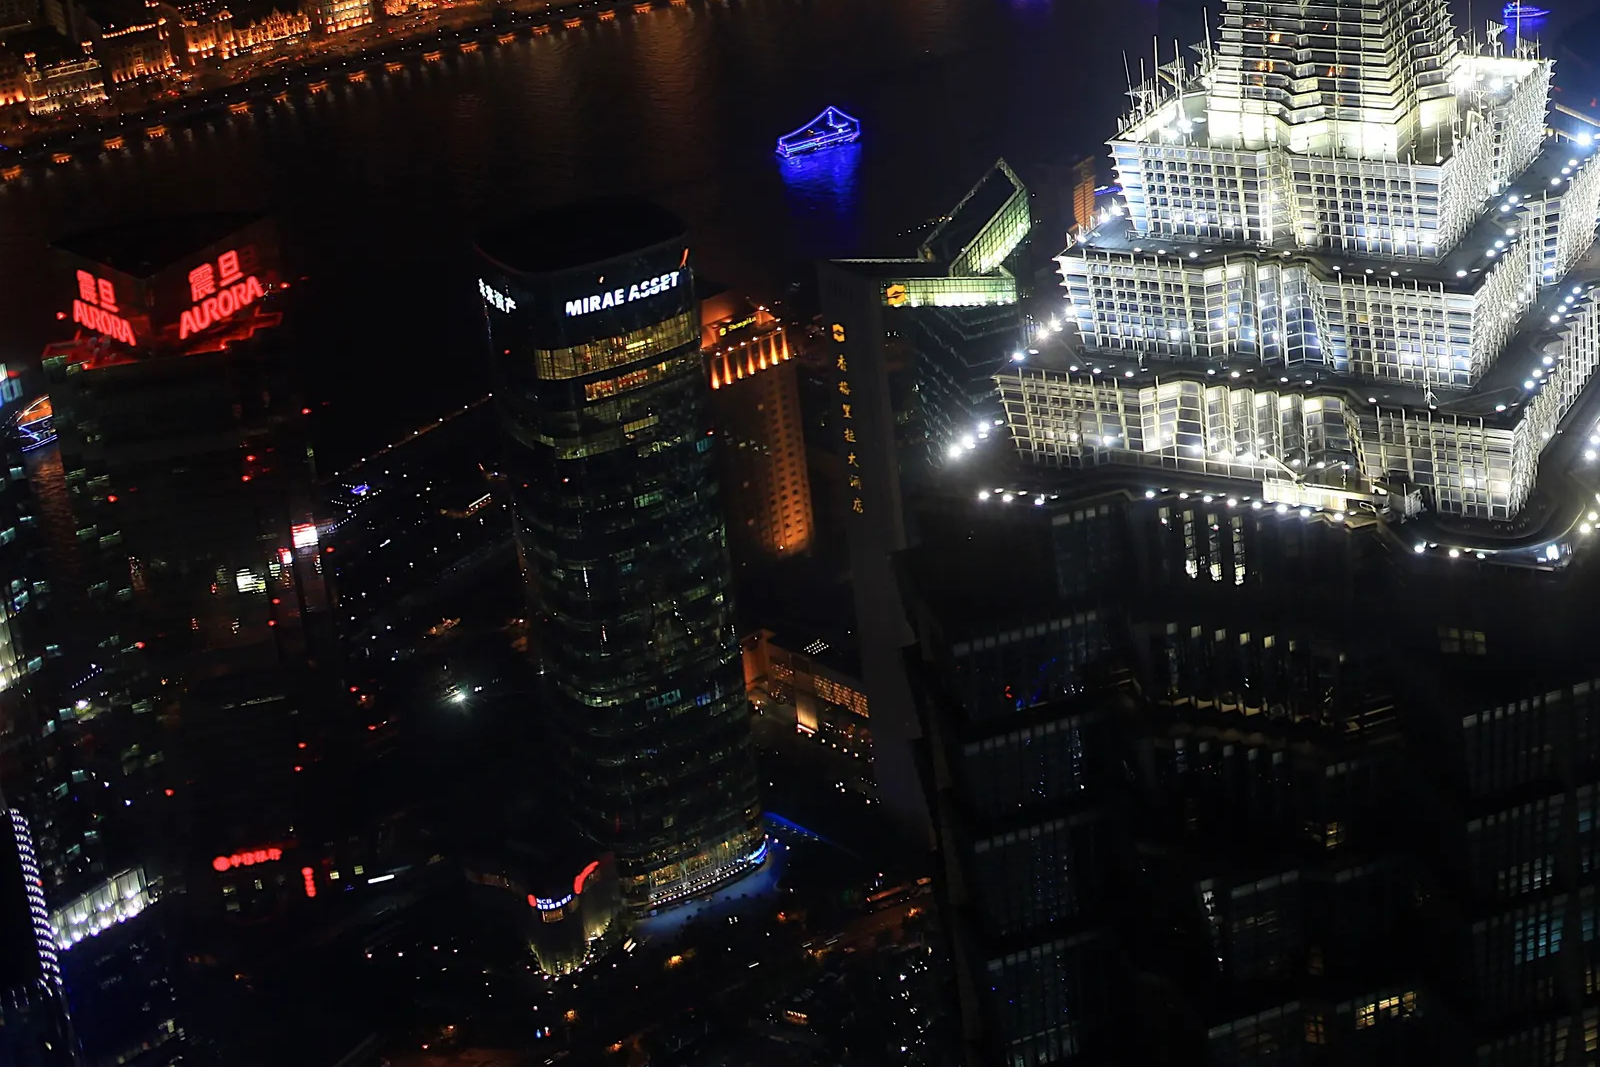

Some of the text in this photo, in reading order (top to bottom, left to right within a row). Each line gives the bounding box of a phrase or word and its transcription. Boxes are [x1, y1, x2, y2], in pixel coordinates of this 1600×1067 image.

[76, 269, 120, 313] 震旦
[188, 249, 244, 302] 震旦
[565, 271, 680, 316] MIRAE ASSET
[72, 299, 137, 347] AURORA
[179, 275, 264, 340] AURORA
